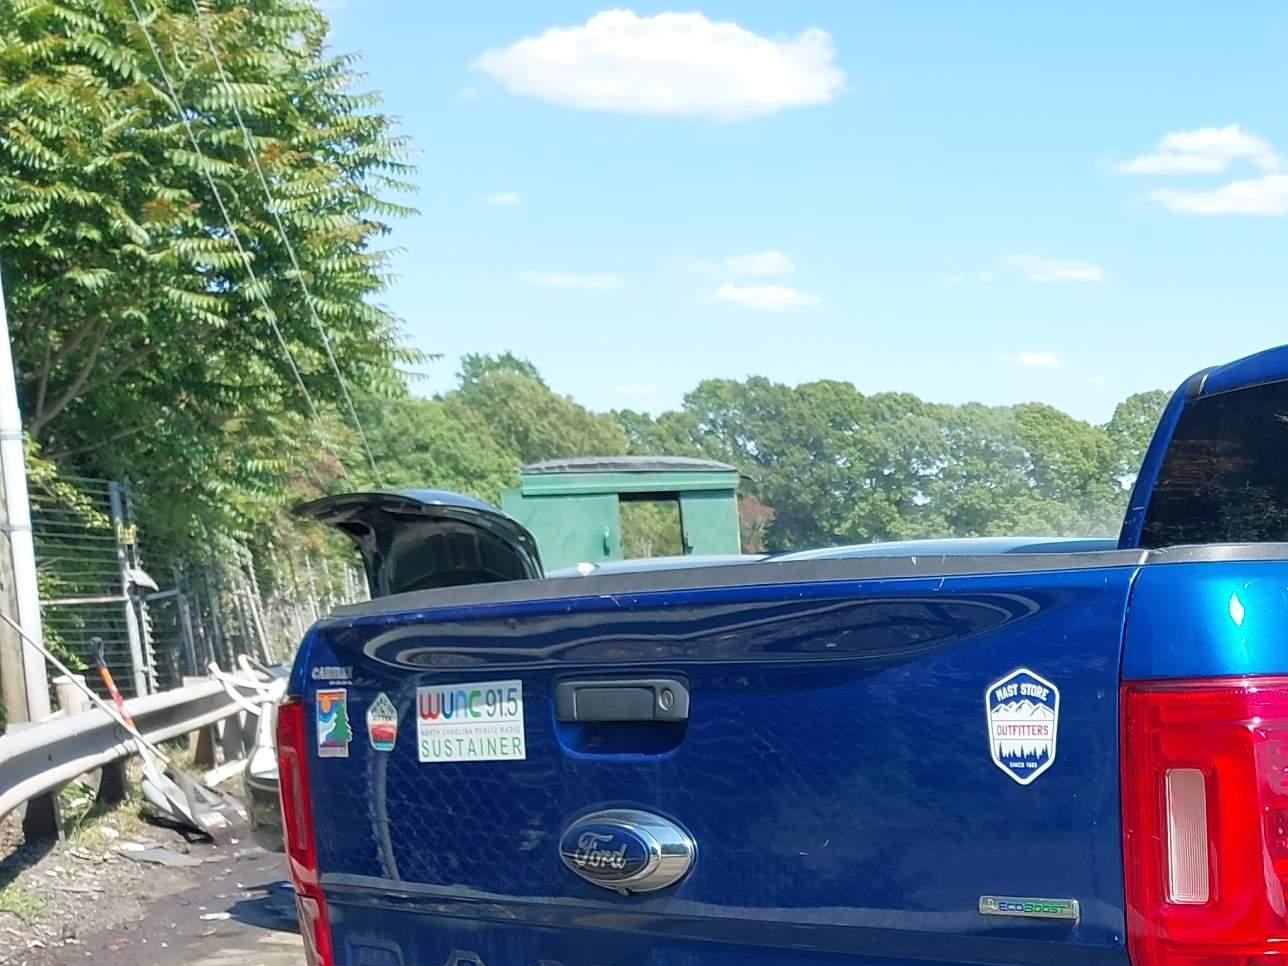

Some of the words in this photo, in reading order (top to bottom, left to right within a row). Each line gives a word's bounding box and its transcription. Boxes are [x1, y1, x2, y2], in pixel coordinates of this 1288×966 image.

[485, 687, 518, 717] 91.5
[996, 683, 1019, 702] MAST
[1020, 683, 1050, 701] STORE
[421, 728, 440, 736] NORTH
[442, 727, 473, 736] CAROLINA
[475, 726, 498, 735] PUBLIC
[500, 725, 521, 734] RADIO
[996, 724, 1049, 737] OUTFITTERS
[421, 736, 523, 758] SUSTAINER
[574, 831, 627, 869] Ford
